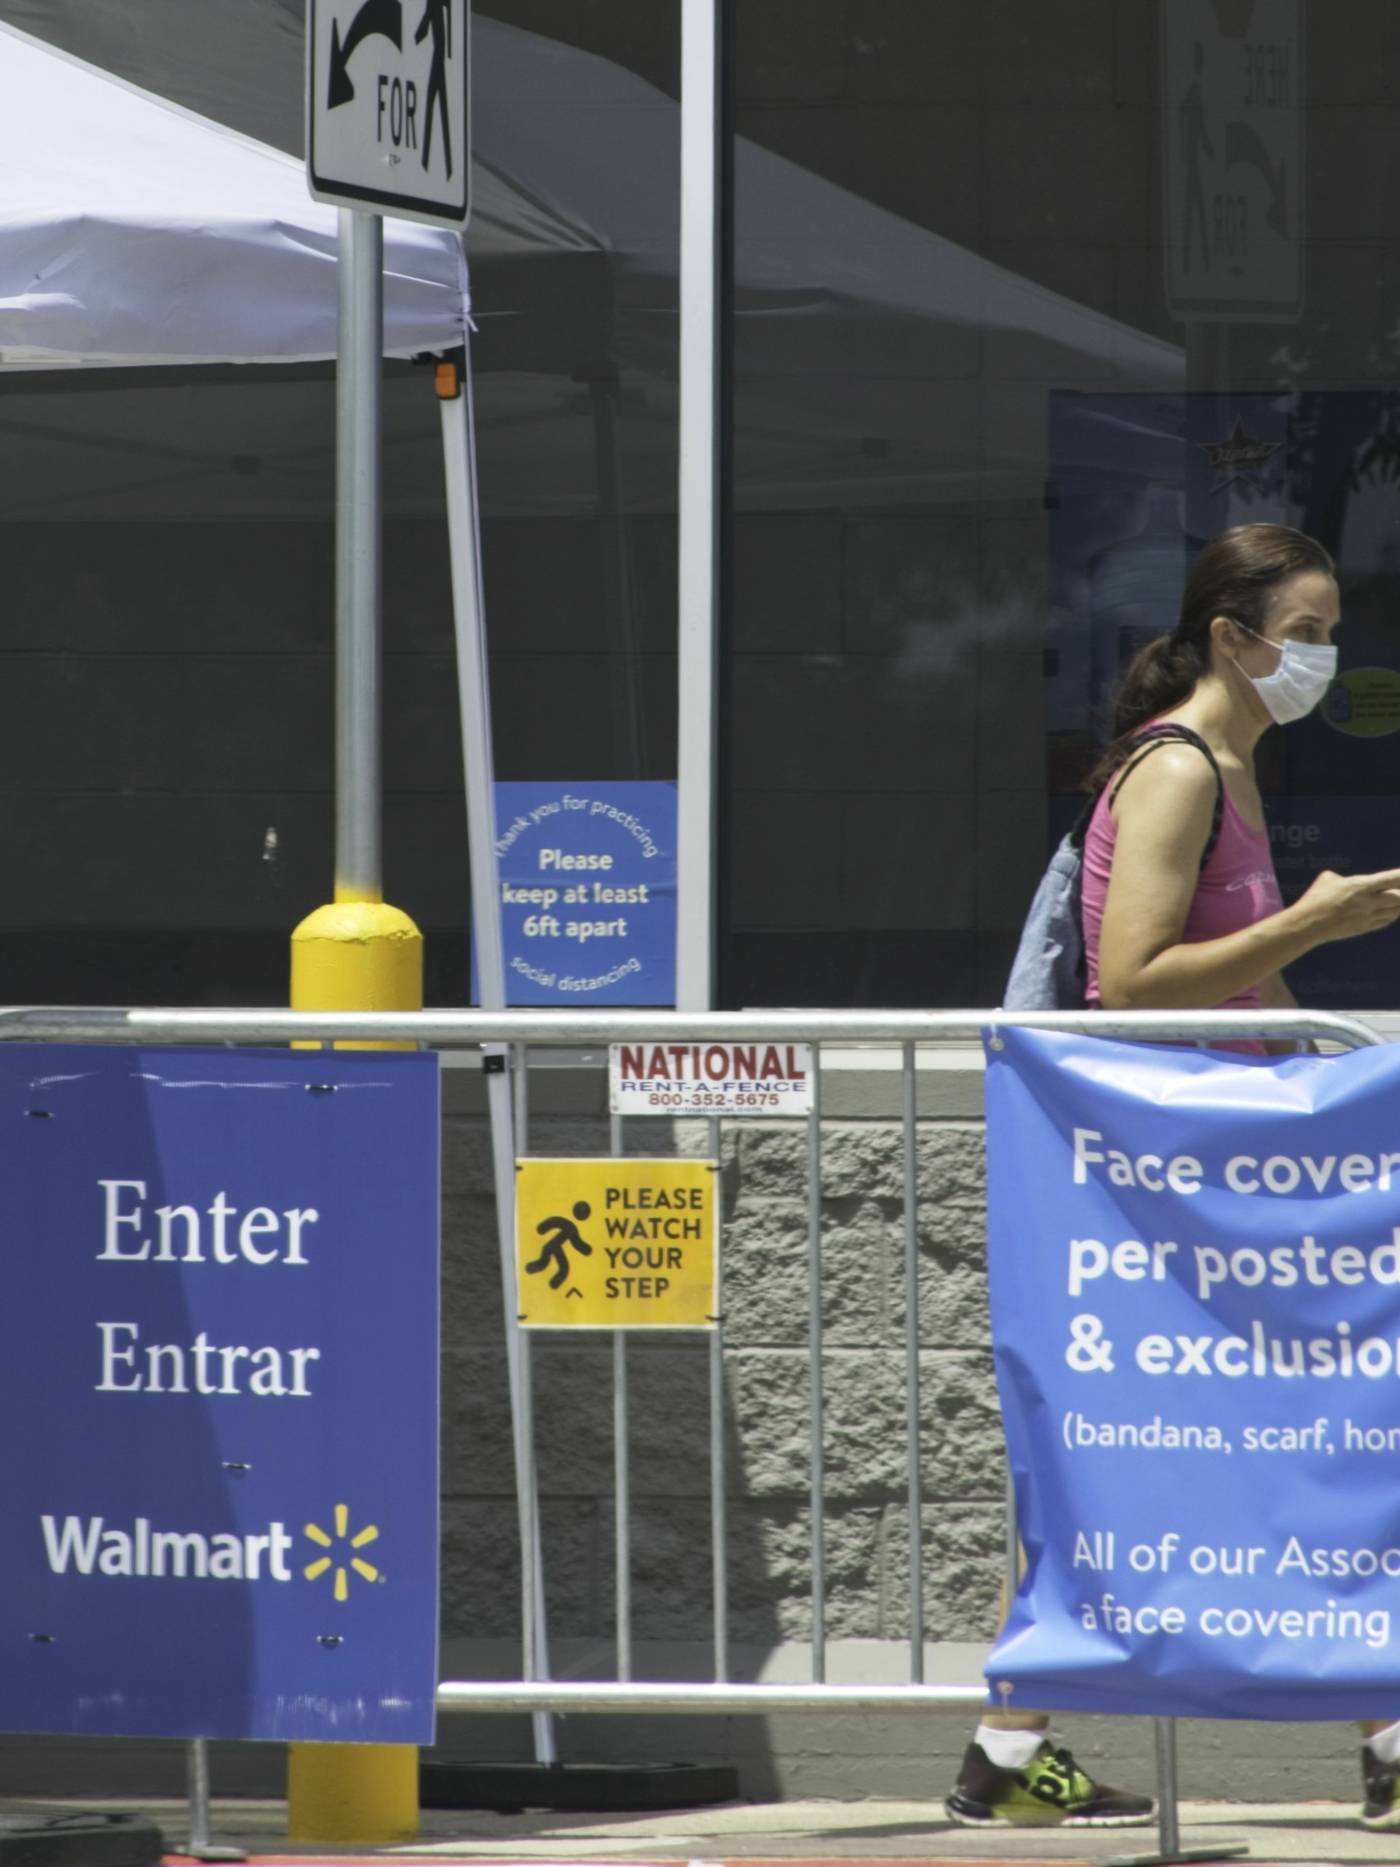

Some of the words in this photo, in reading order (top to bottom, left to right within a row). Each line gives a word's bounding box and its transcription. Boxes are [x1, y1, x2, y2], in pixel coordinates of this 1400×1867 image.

[377, 74, 418, 150] FOR
[530, 801, 560, 825] you
[562, 795, 590, 811] for
[590, 801, 658, 859] practicing
[539, 848, 614, 871] Please
[502, 883, 558, 910] keep
[563, 887, 588, 904] at
[594, 882, 650, 904] least
[522, 915, 561, 937] 6ft
[565, 917, 628, 944] apart
[510, 956, 557, 988] social
[557, 956, 642, 992] distancing
[620, 1045, 806, 1081] NATIONAL
[620, 1081, 808, 1093] RENT-A-FENCE
[648, 1093, 780, 1107] 800-352-5675
[1073, 1127, 1204, 1196] Face
[605, 1187, 704, 1210] PLEASE
[95, 1179, 319, 1265] Enter
[604, 1216, 701, 1240] WATCH
[604, 1246, 683, 1270] YOUR
[1068, 1238, 1178, 1297] per
[604, 1276, 670, 1299] STEP
[94, 1322, 321, 1397] Entrar
[1065, 1313, 1116, 1374] &
[1062, 1411, 1233, 1454] (bandana,
[1243, 1417, 1335, 1454] scarf,
[41, 1515, 293, 1582] Walmart
[1073, 1531, 1115, 1570] All
[1128, 1532, 1180, 1573] of
[1189, 1545, 1266, 1575] our
[1081, 1603, 1097, 1631] a
[1100, 1593, 1187, 1635] face
[1199, 1600, 1390, 1649] covering
